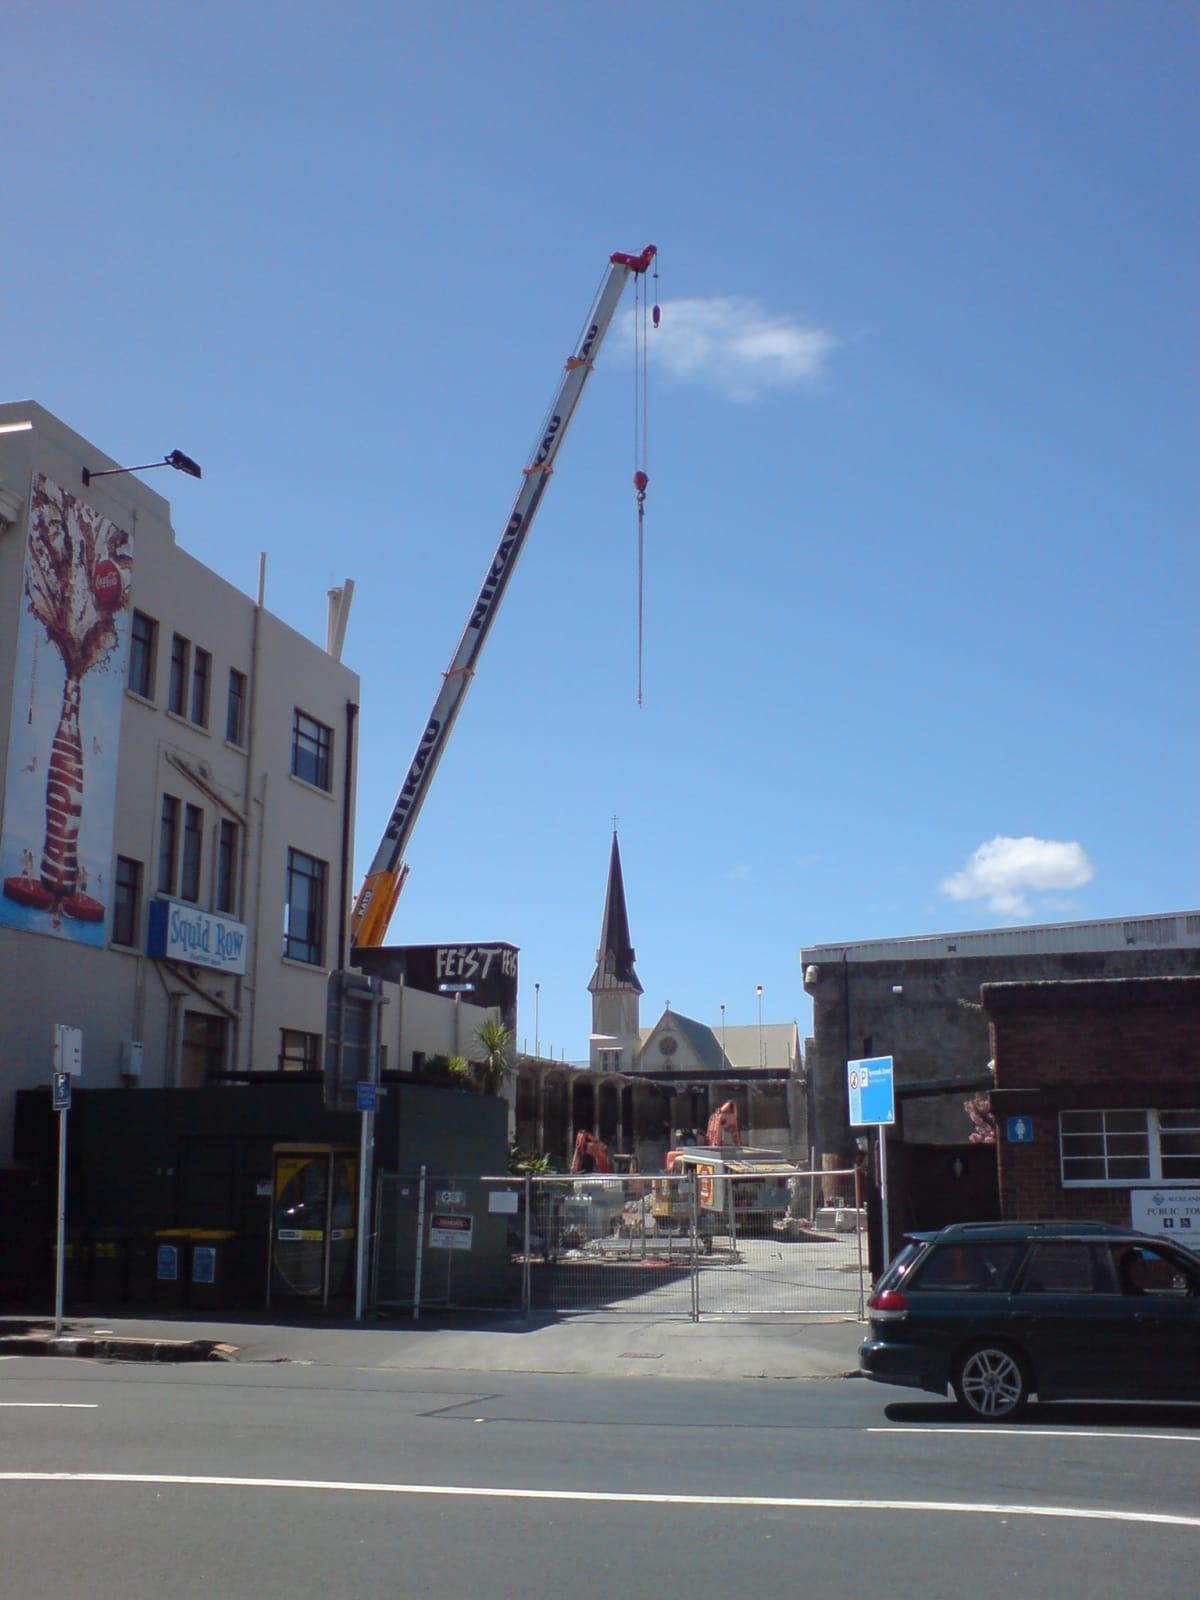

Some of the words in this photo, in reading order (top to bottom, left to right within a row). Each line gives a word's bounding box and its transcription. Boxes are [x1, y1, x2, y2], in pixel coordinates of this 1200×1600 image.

[469, 513, 523, 630] NIKAU
[385, 719, 441, 841] NIKAU
[357, 889, 373, 918] KATO
[170, 909, 211, 953] Squid
[58, 1074, 66, 1087] P
[1147, 1207, 1179, 1216] PUBLIC
